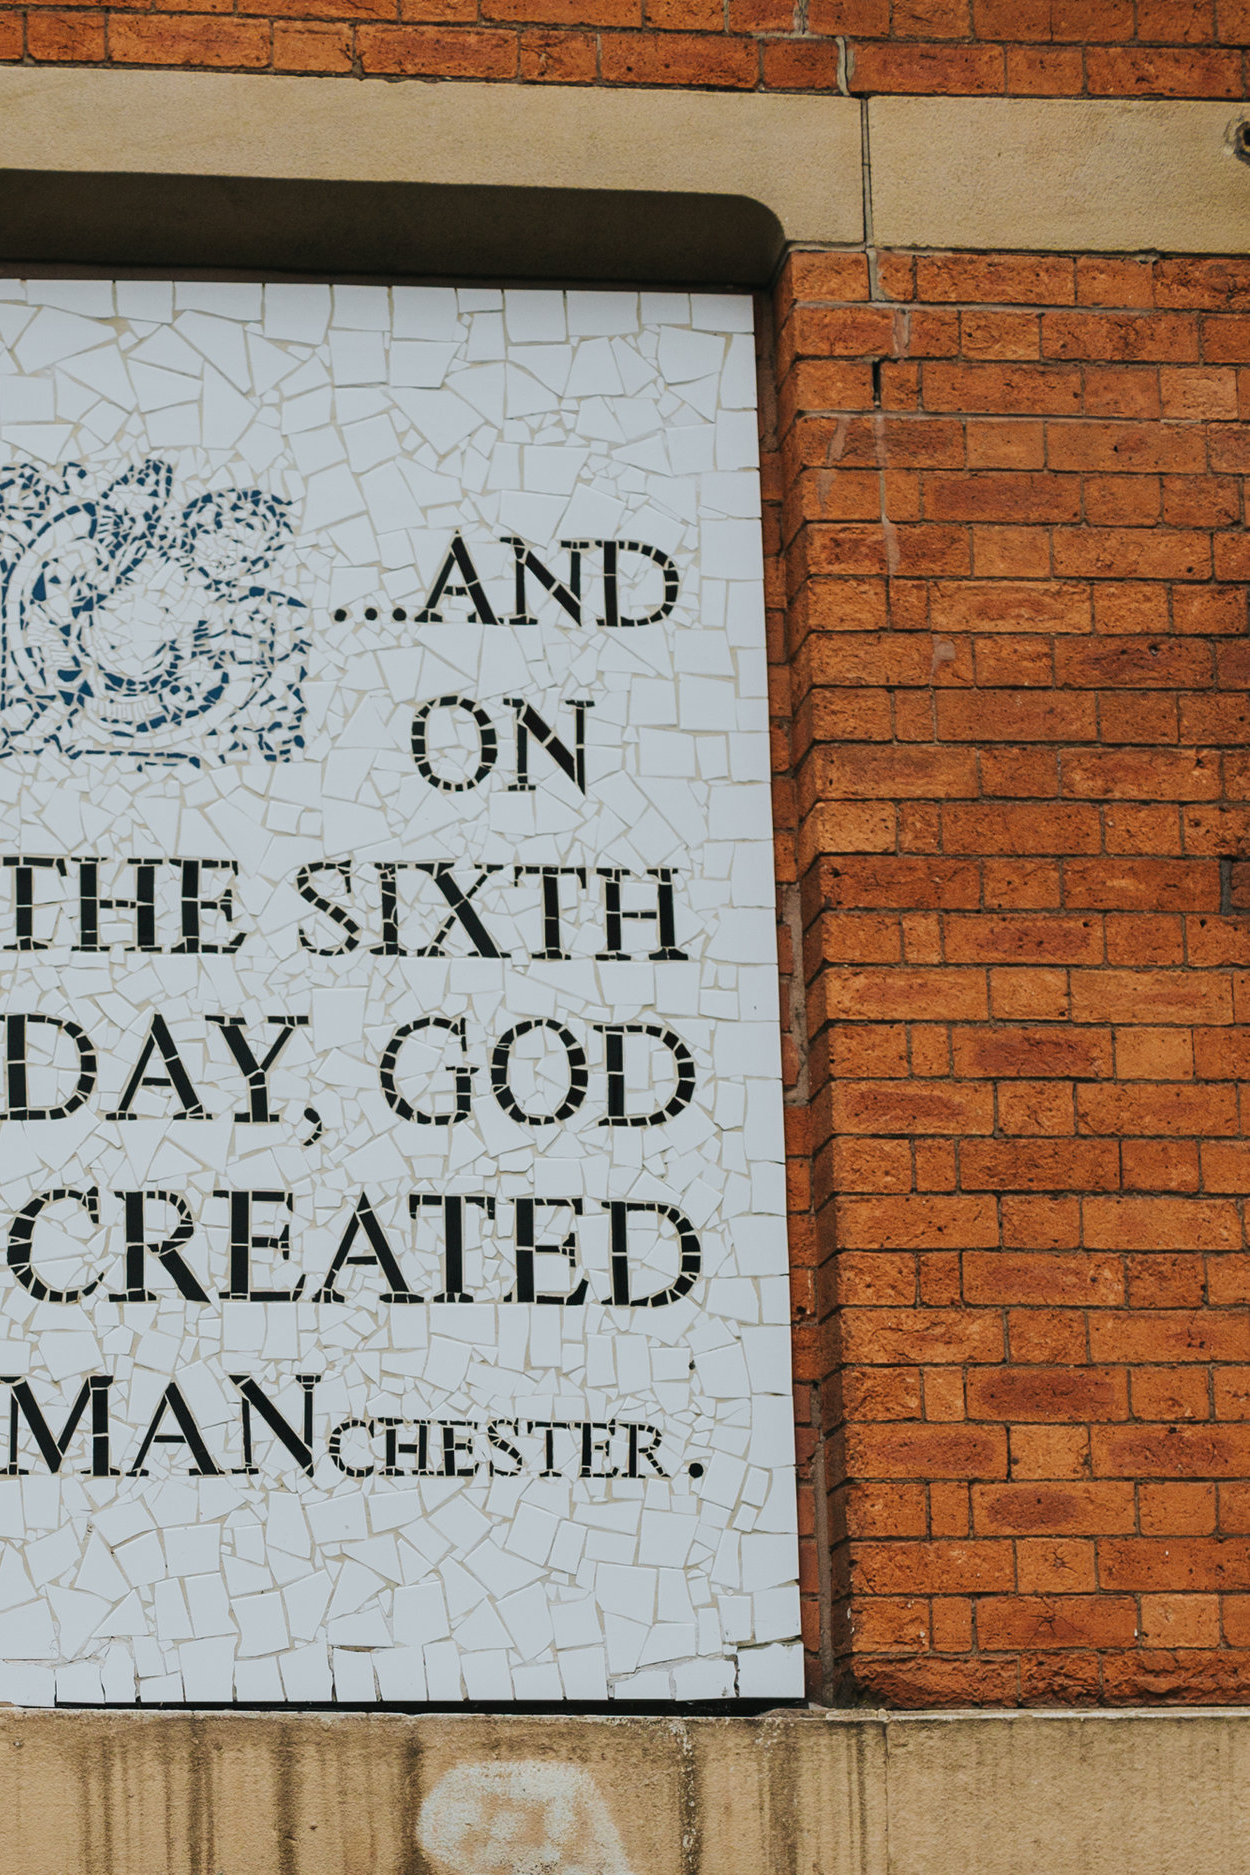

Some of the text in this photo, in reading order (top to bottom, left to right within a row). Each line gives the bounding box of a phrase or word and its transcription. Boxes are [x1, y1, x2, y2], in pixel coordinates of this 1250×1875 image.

[412, 696, 595, 794] ON
[297, 860, 690, 962] SIXTH
[380, 1017, 696, 1127] GOD
[7, 1187, 702, 1306] CREATED
